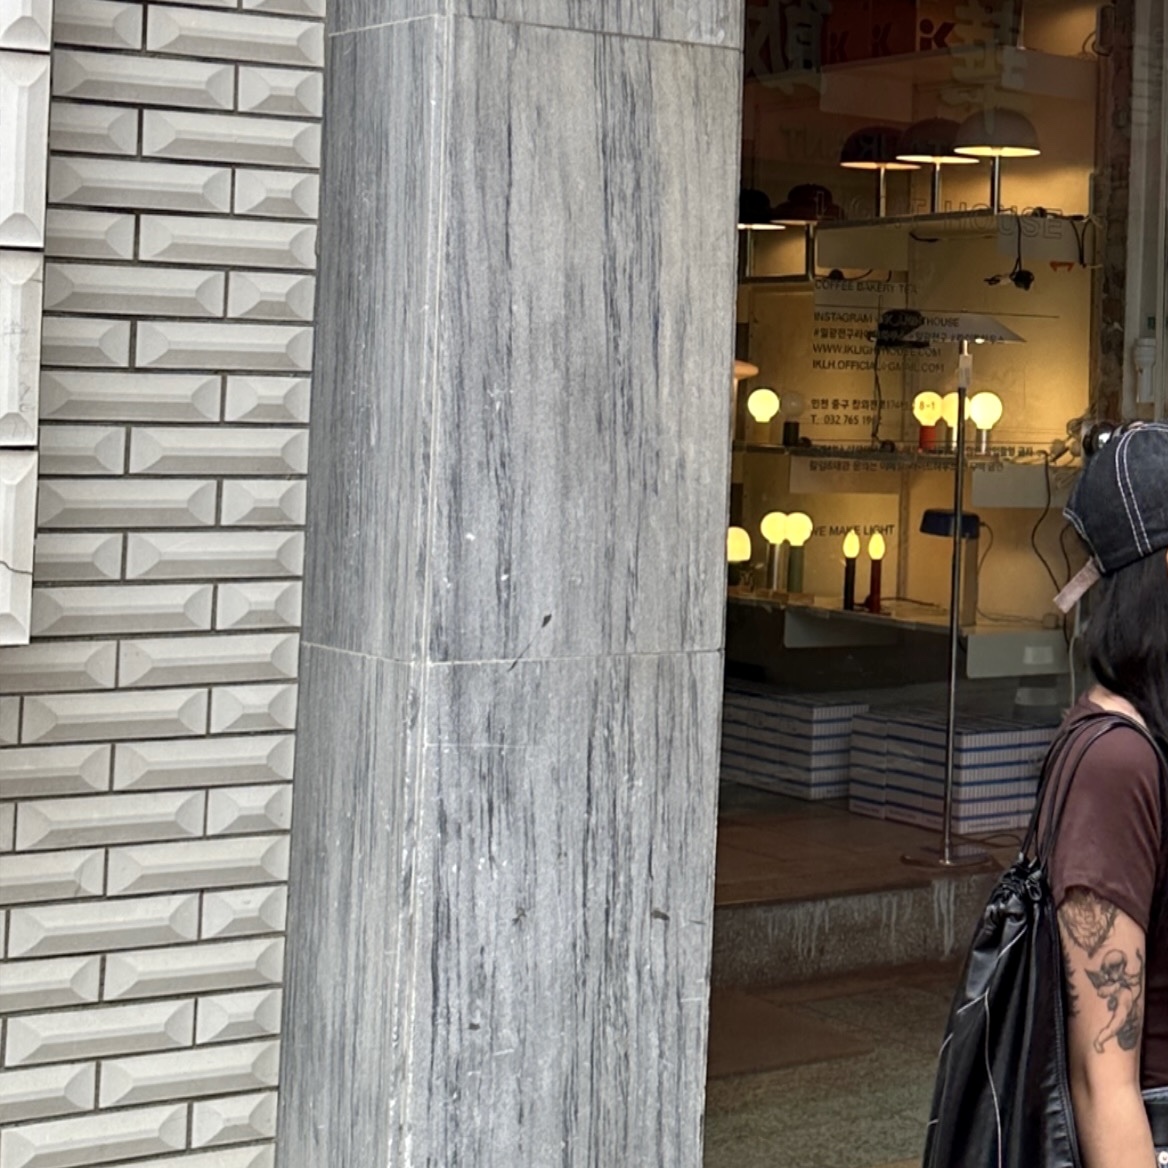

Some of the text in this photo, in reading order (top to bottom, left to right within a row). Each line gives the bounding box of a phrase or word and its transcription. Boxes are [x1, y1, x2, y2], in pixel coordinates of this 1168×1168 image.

[813, 312, 873, 323] INSTAGRAM
[810, 399, 829, 411] 인천
[823, 414, 841, 425] 032
[843, 415, 859, 426] 765
